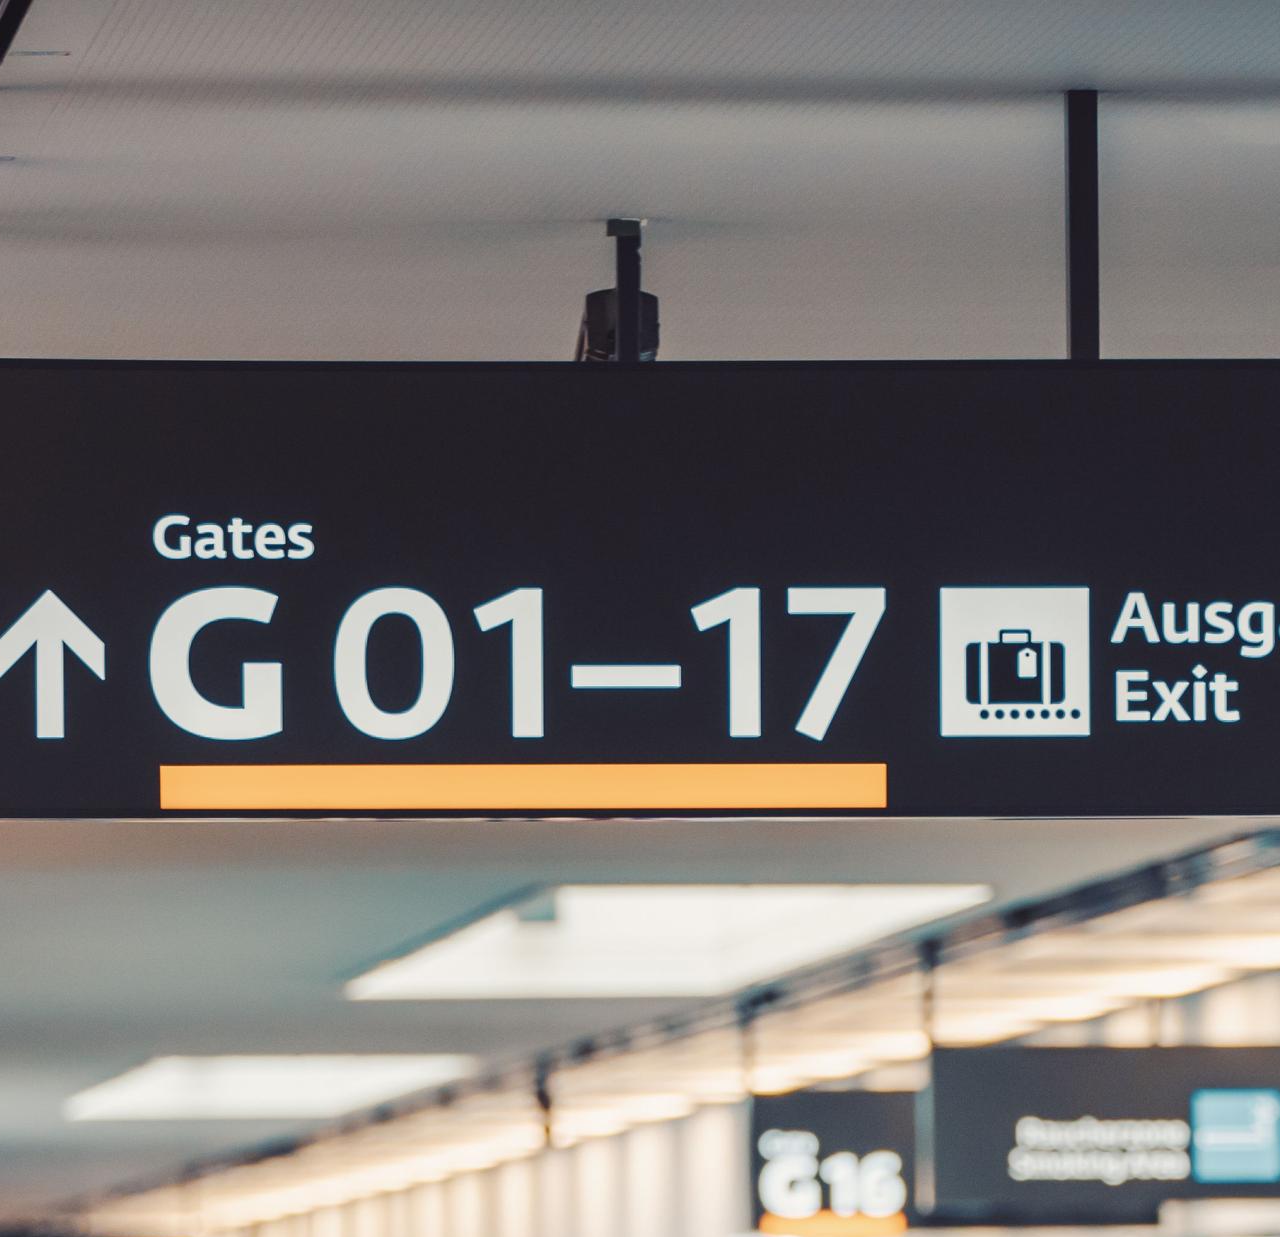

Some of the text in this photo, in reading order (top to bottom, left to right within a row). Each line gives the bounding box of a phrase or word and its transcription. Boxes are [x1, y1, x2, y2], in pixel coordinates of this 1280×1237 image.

[153, 514, 316, 560] Gates
[149, 586, 283, 741] G
[1115, 662, 1241, 723] Exit
[758, 1150, 907, 1219] G 16
